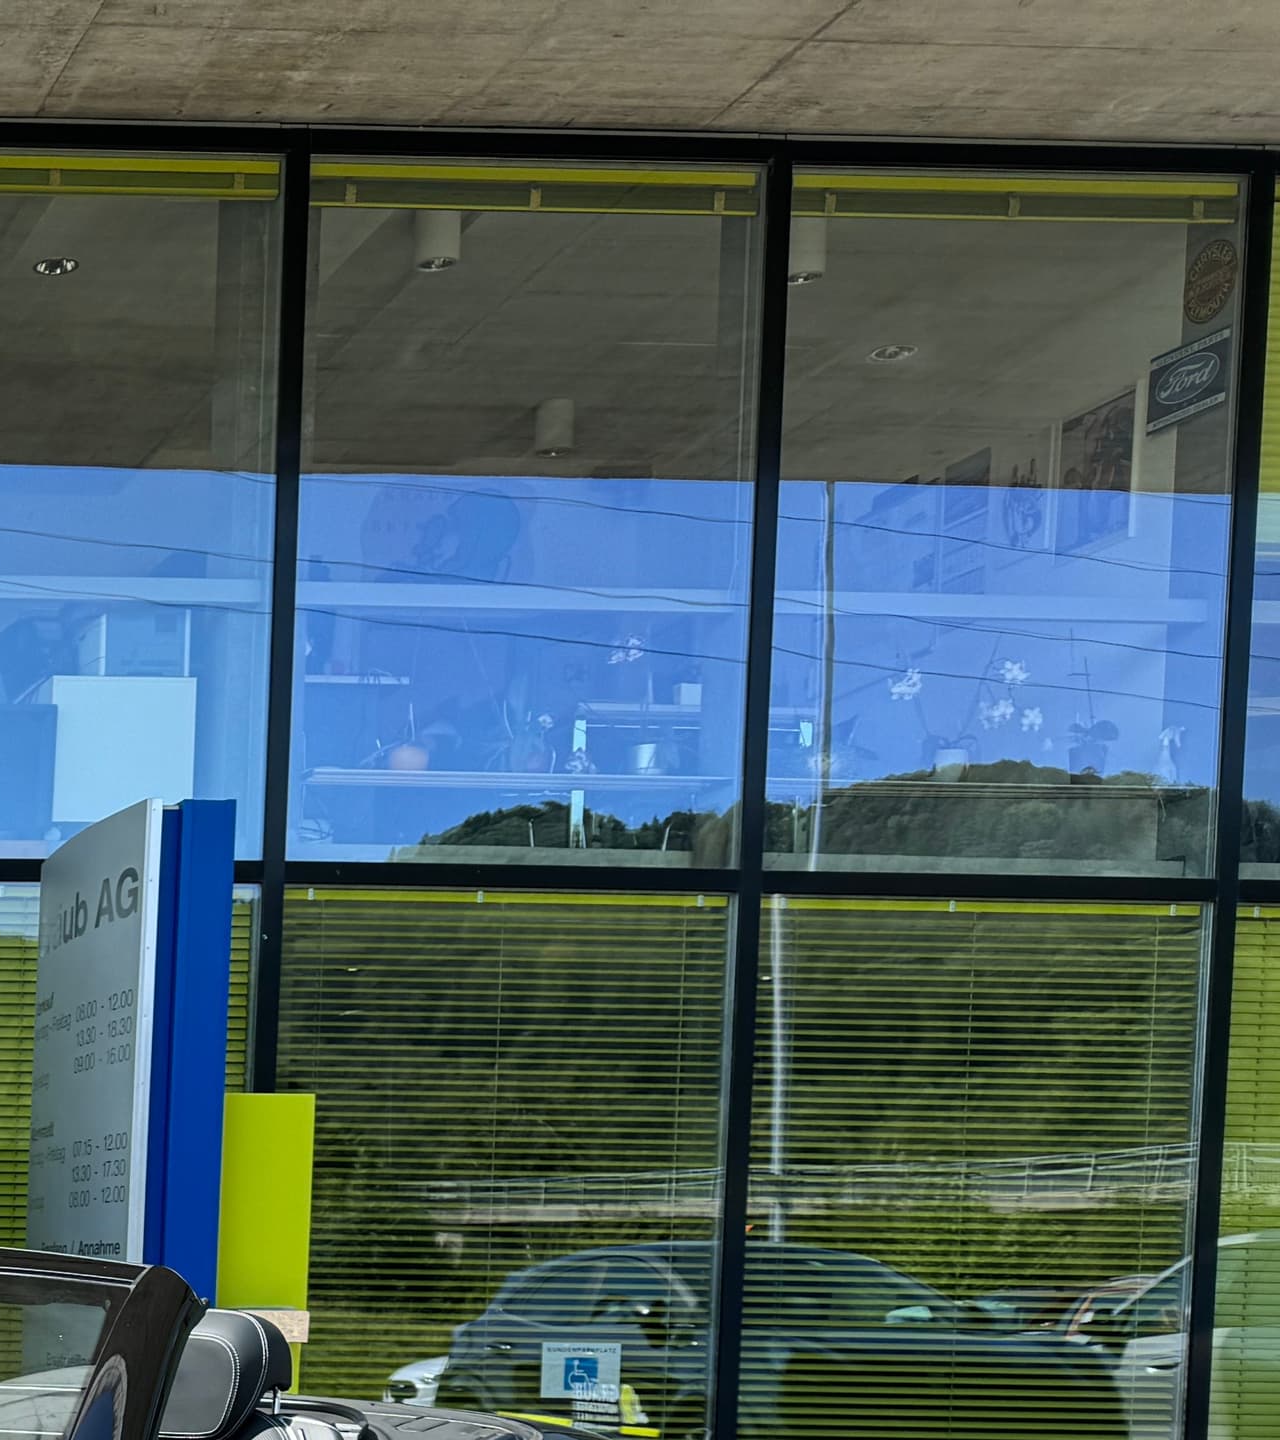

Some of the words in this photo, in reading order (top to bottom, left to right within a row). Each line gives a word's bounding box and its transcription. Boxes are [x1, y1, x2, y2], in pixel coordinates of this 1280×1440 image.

[1160, 360, 1215, 399] Ford
[95, 867, 139, 929] AG
[108, 988, 134, 1011] 12.00
[103, 1131, 128, 1152] 12.00
[102, 1158, 127, 1178] 17.30
[100, 1184, 126, 1204] 12.00
[78, 1240, 121, 1256] Annahme
[546, 1346, 617, 1354] KUNDENPARKPLATZ
